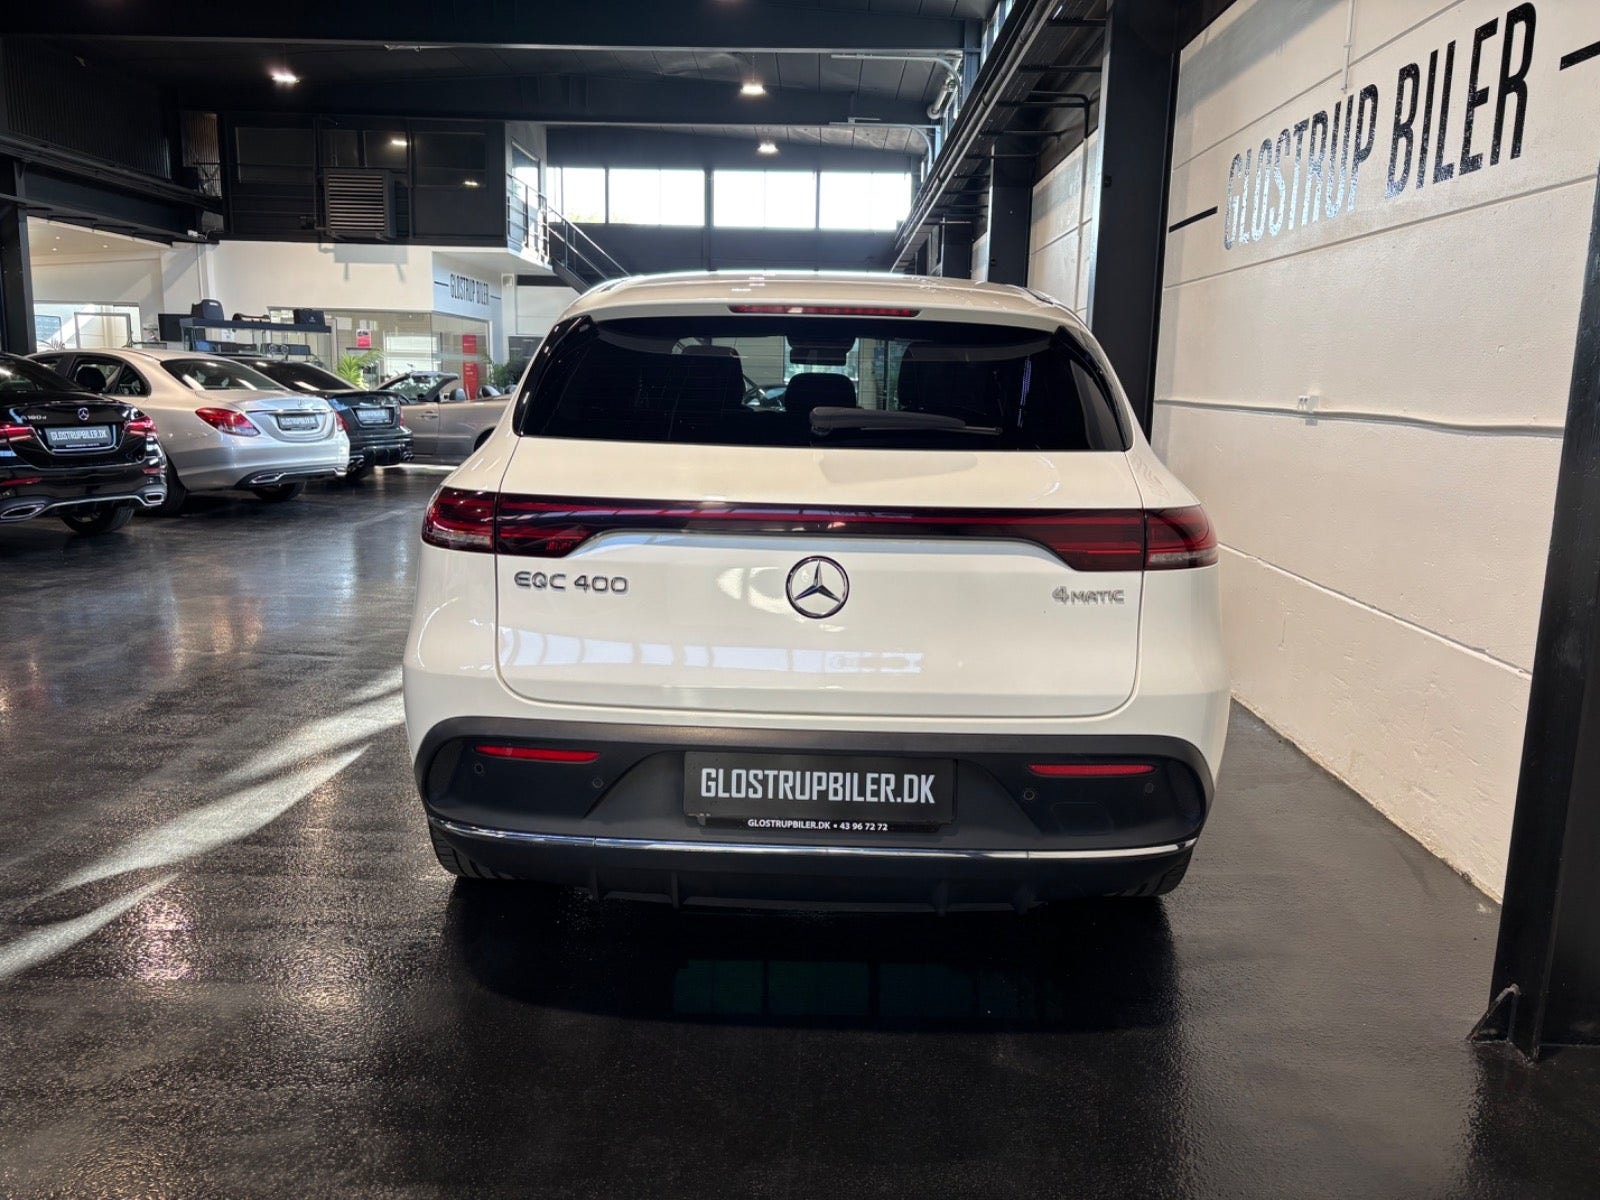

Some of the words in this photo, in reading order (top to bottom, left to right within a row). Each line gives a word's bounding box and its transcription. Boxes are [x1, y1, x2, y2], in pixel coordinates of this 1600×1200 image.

[1223, 83, 1379, 250] GLOSTRUP
[1384, 2, 1537, 199] BILER
[450, 273, 475, 303] GLOSTRUP
[514, 570, 567, 590] EQC
[573, 575, 628, 594] 400
[700, 767, 936, 804] GLOSTRUPBILER.DK
[747, 818, 831, 830] GLOSTRUPBILER.DK
[839, 821, 851, 830] 43
[852, 822, 864, 831] 96
[865, 822, 876, 831] 72
[877, 822, 888, 831] 72
